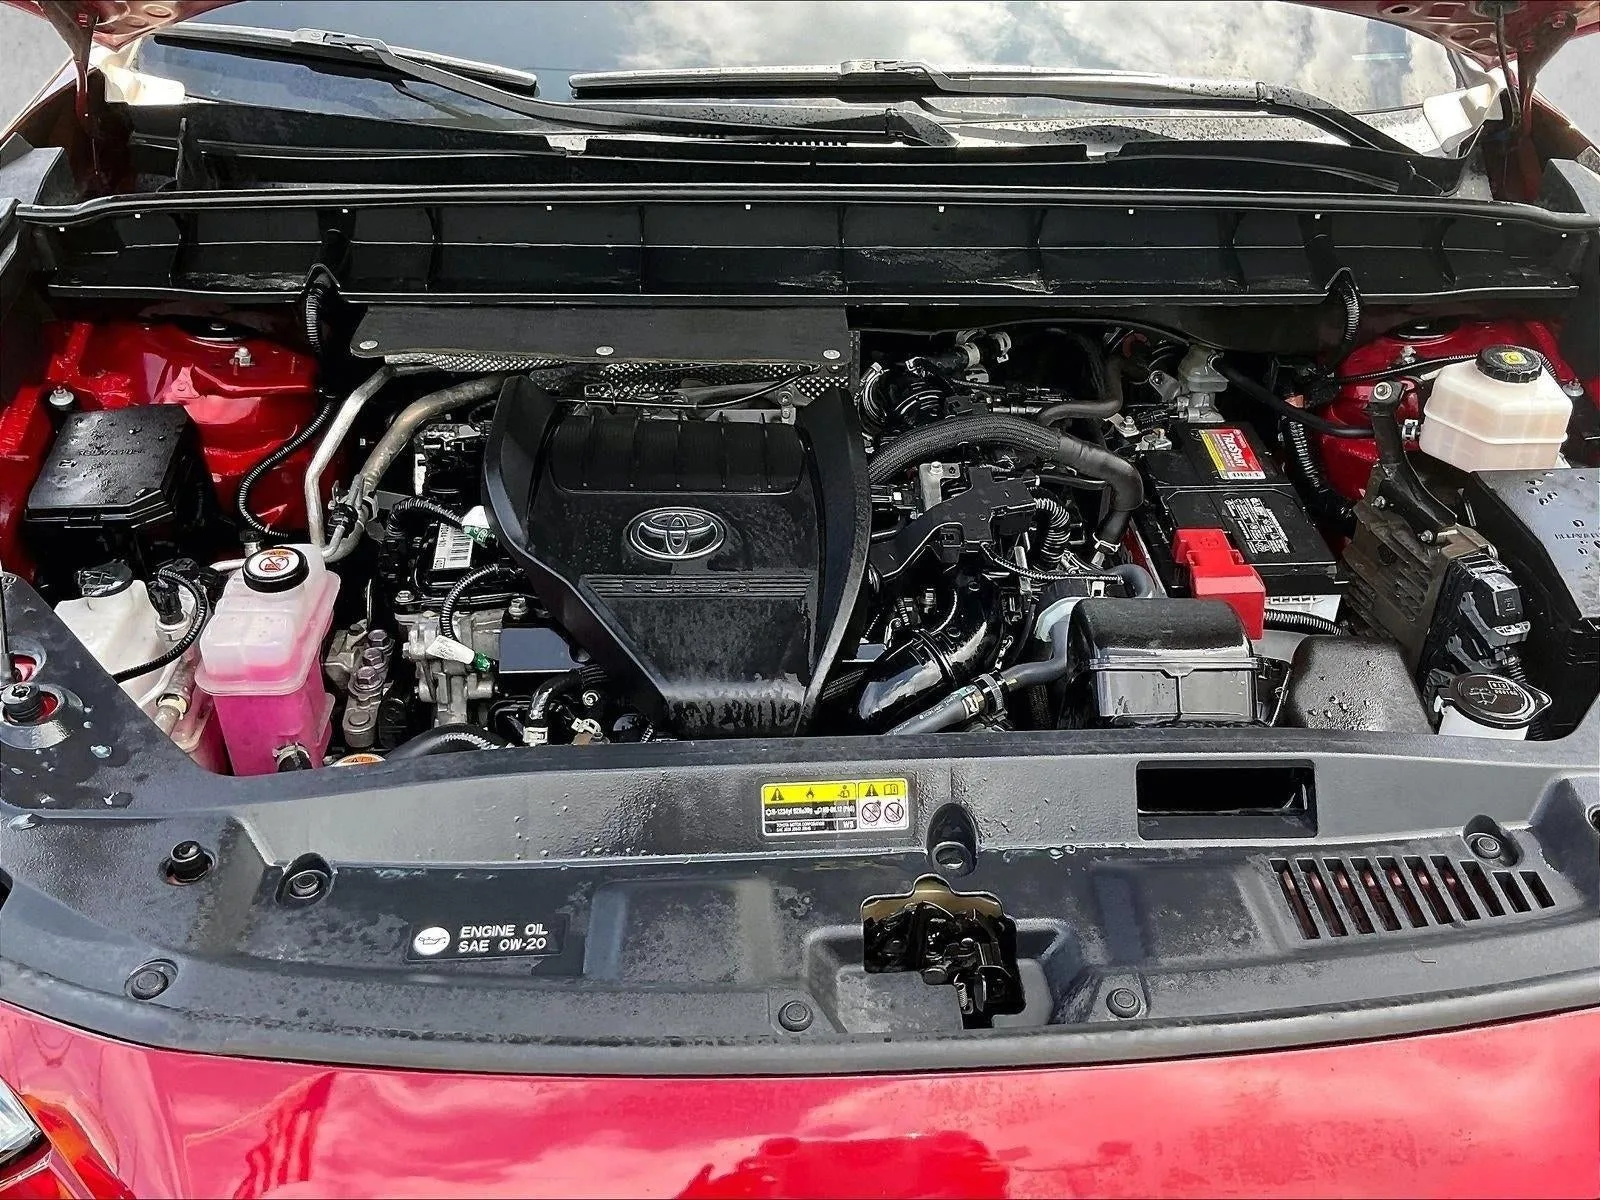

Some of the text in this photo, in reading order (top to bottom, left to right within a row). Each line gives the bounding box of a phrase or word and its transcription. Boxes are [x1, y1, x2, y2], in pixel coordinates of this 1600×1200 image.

[460, 923, 549, 938] ENGINE OIL
[458, 937, 547, 953] SAE 0W-20
